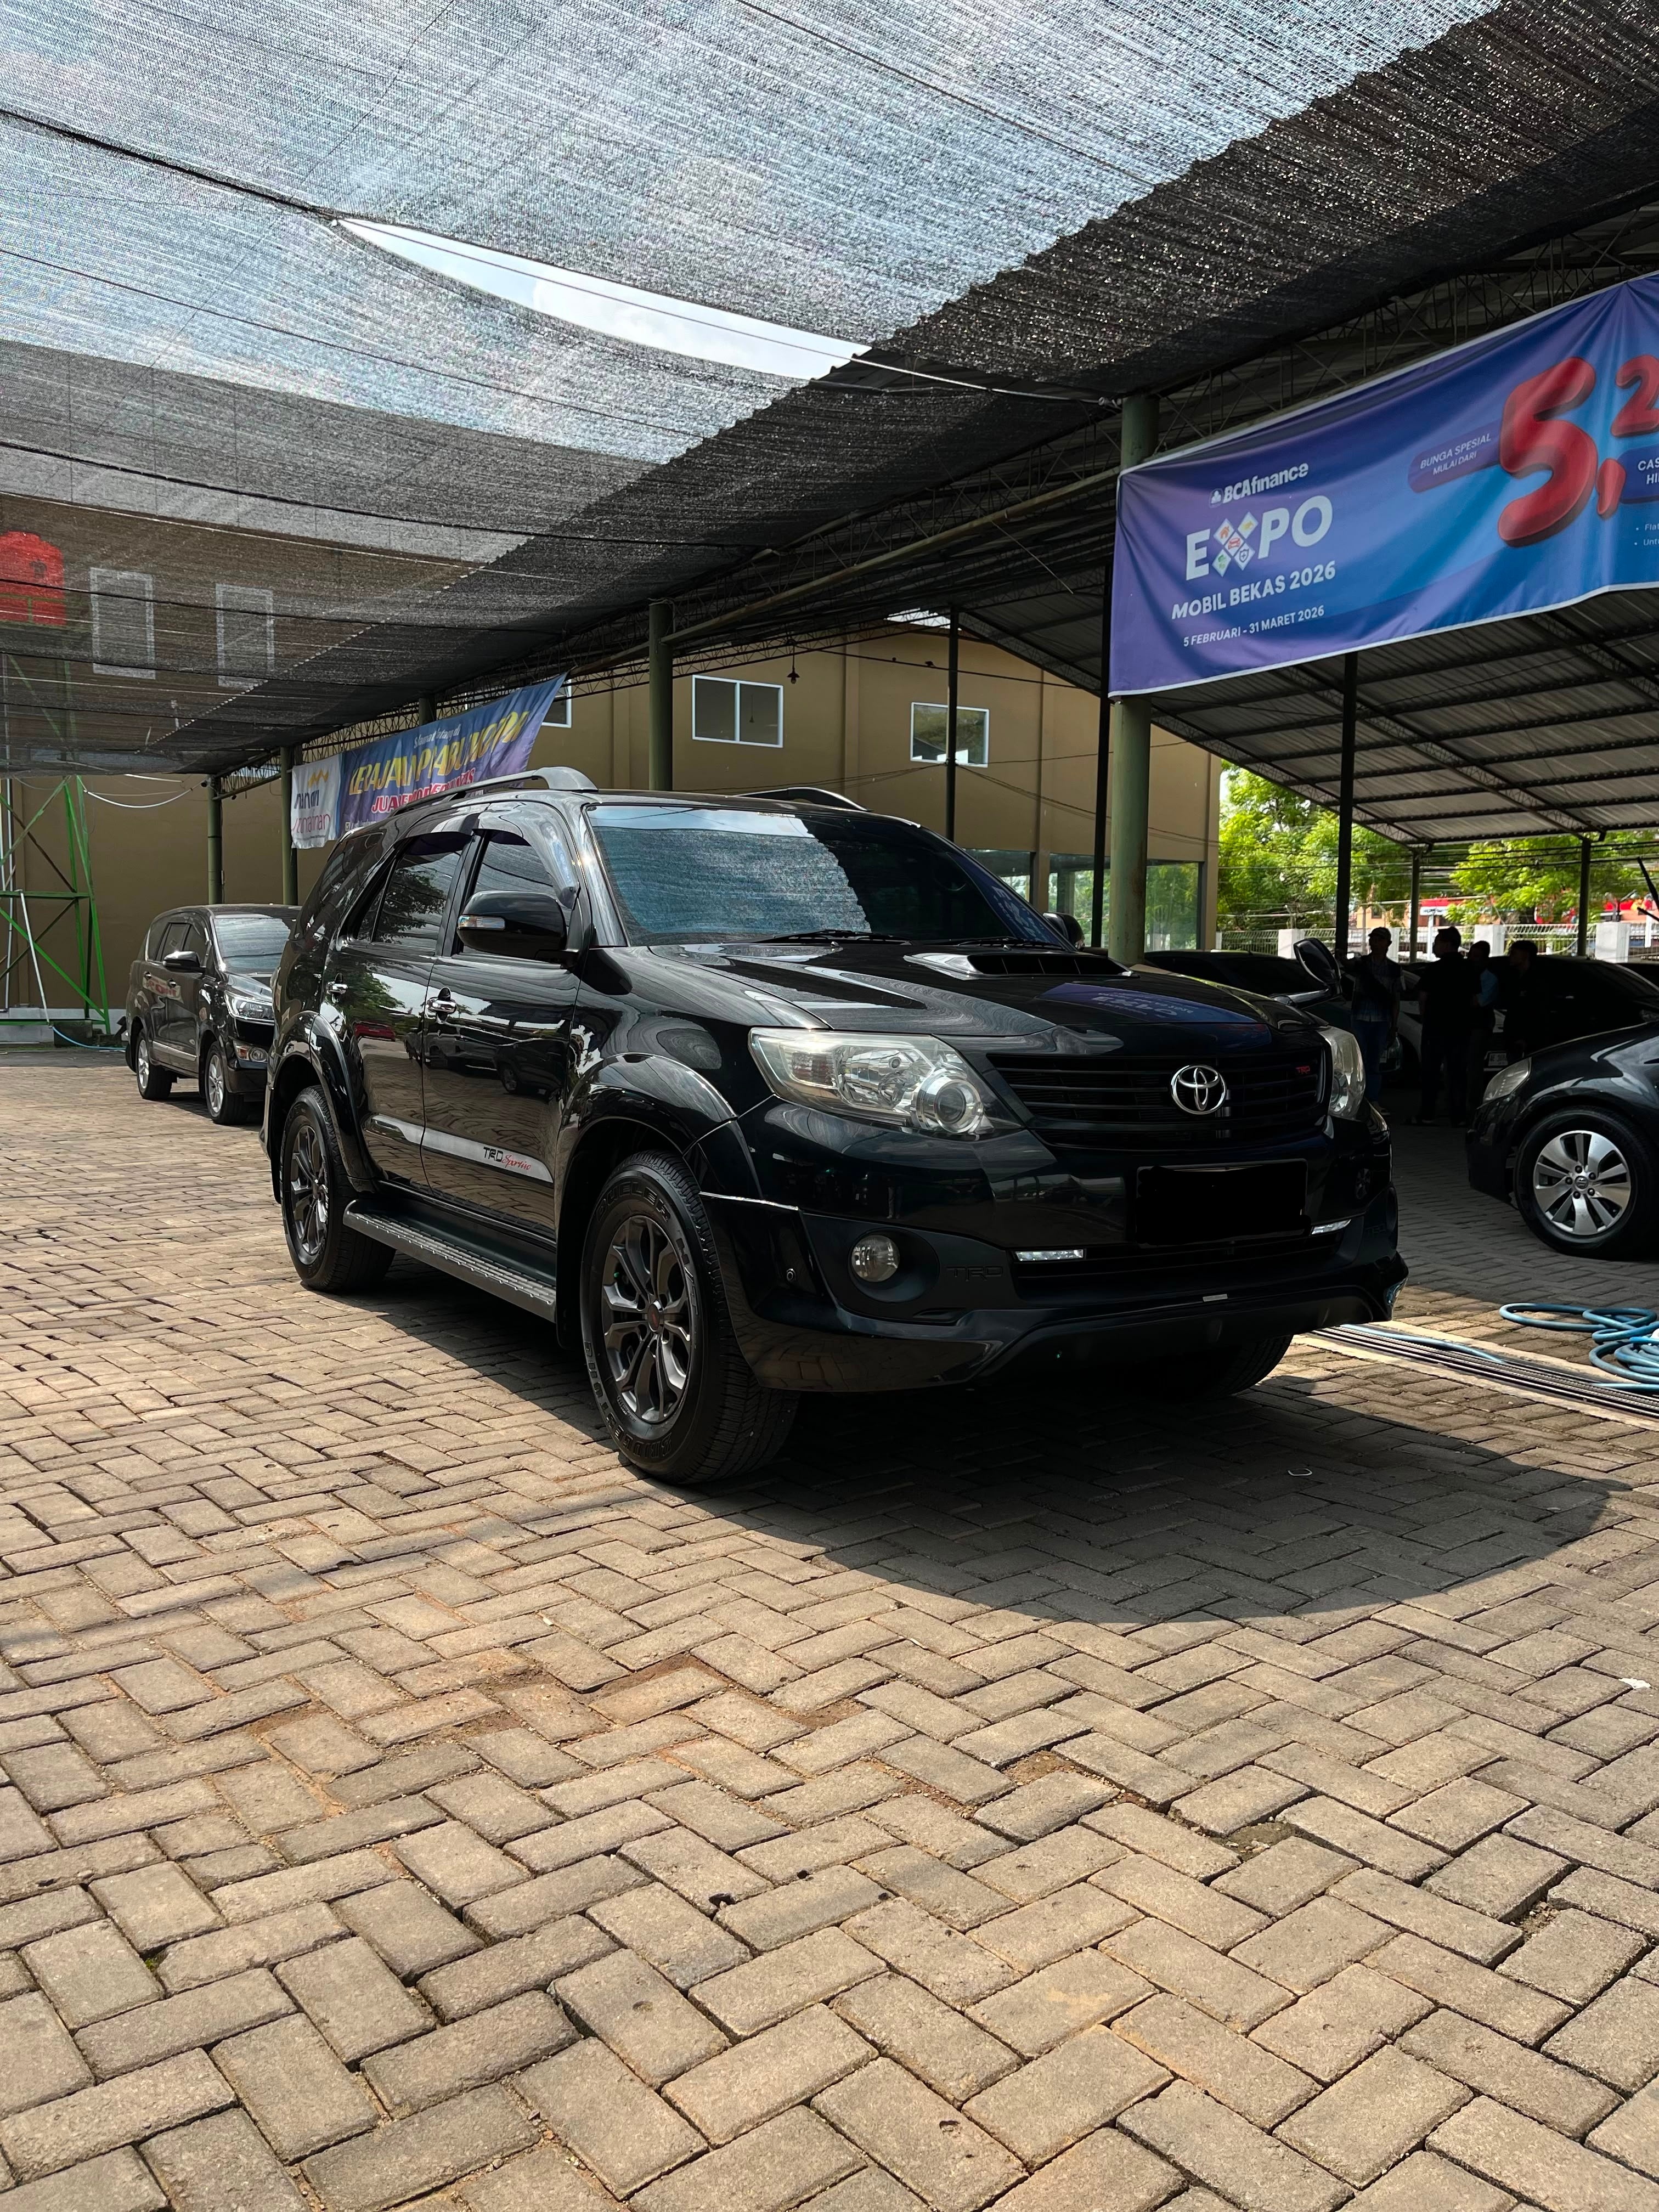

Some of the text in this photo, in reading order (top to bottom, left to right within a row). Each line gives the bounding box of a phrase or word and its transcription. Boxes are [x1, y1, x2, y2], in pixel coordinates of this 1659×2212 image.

[1420, 433, 1492, 469] BUNGA SPESIAL
[1432, 451, 1477, 475] MULAI DARI
[1646, 472, 1659, 484] HI
[1186, 495, 1333, 580] EXPO
[1172, 561, 1336, 619] MOBIL BEKAS 2026
[1183, 636, 1189, 647] 5
[1190, 627, 1241, 646] FEBRUARI
[1249, 622, 1260, 634] 31
[1261, 612, 1296, 631] MARET
[1298, 605, 1325, 622] 2026
[483, 1146, 504, 1163] TRD
[945, 1266, 1003, 1282] TRD
